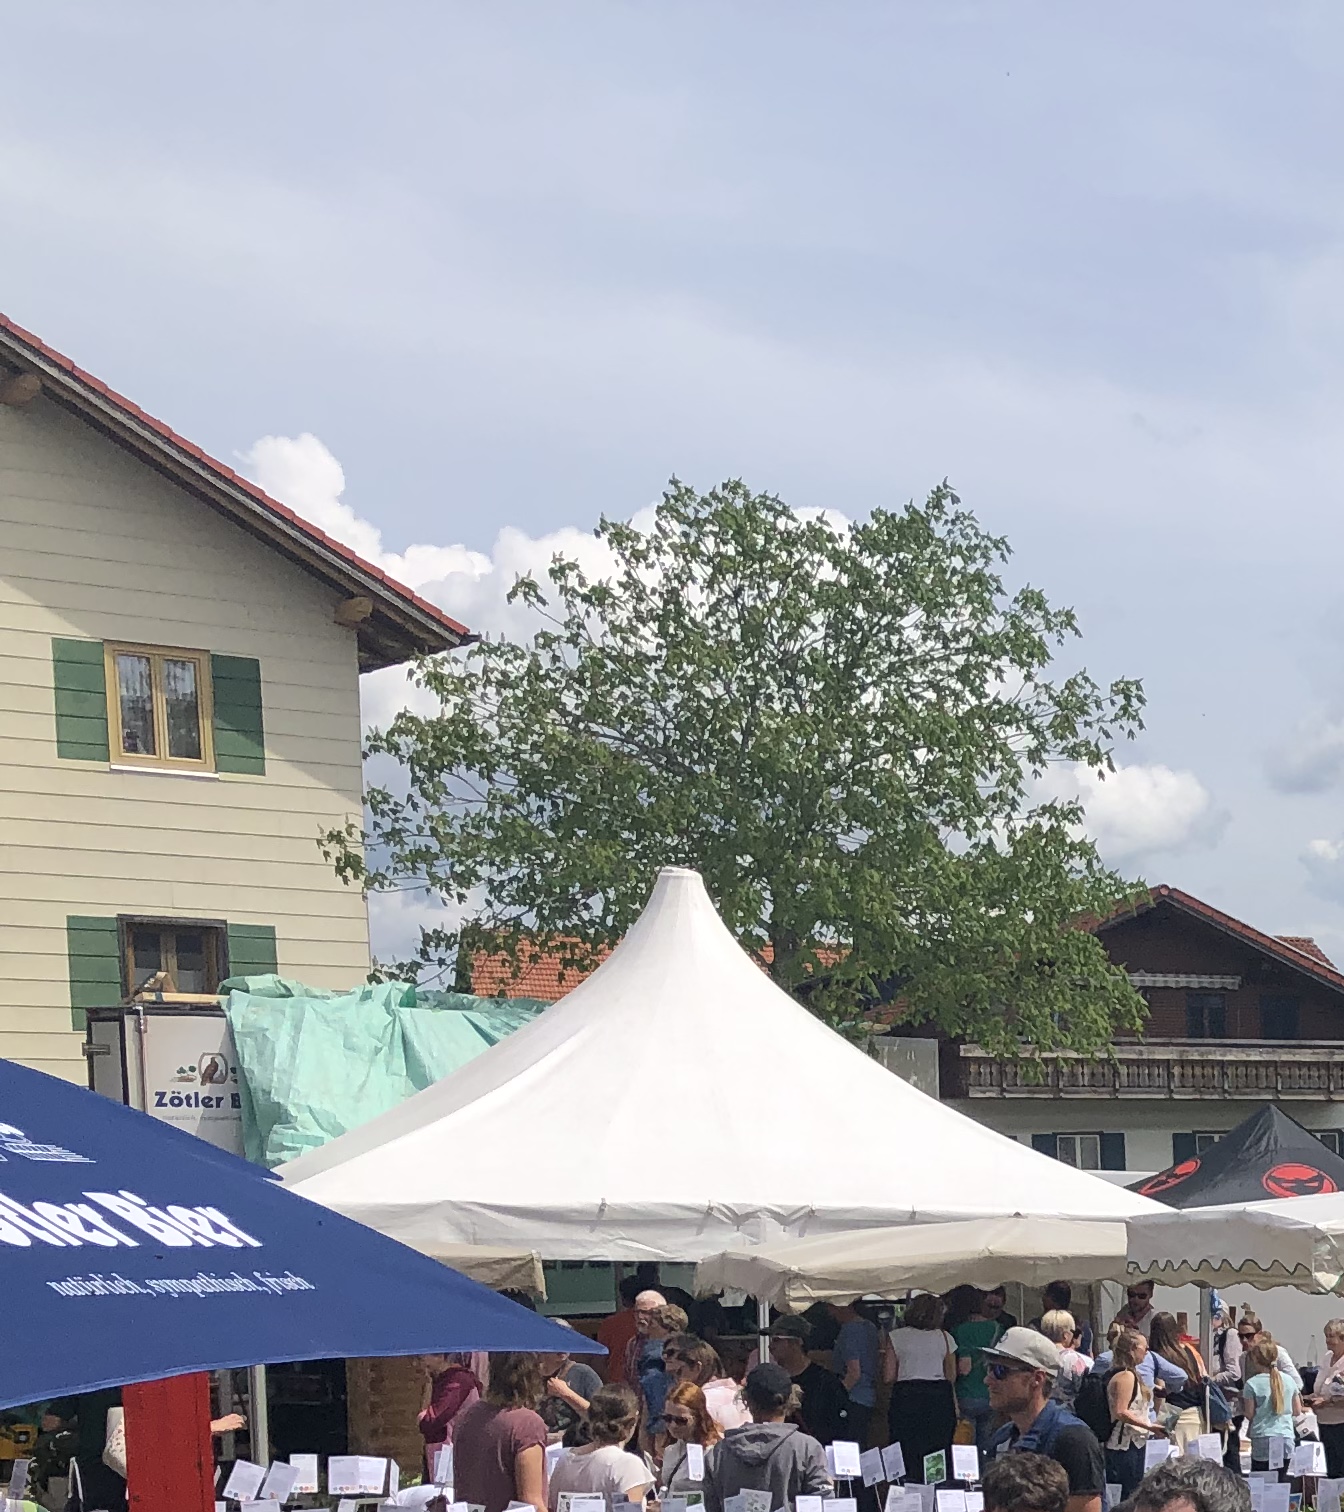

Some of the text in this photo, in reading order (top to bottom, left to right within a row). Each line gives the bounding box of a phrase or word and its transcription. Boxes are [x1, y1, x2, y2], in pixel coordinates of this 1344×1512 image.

[154, 1090, 225, 1109] Zötler
[81, 1188, 265, 1248] Bier
[46, 1272, 156, 1297] natürlich,
